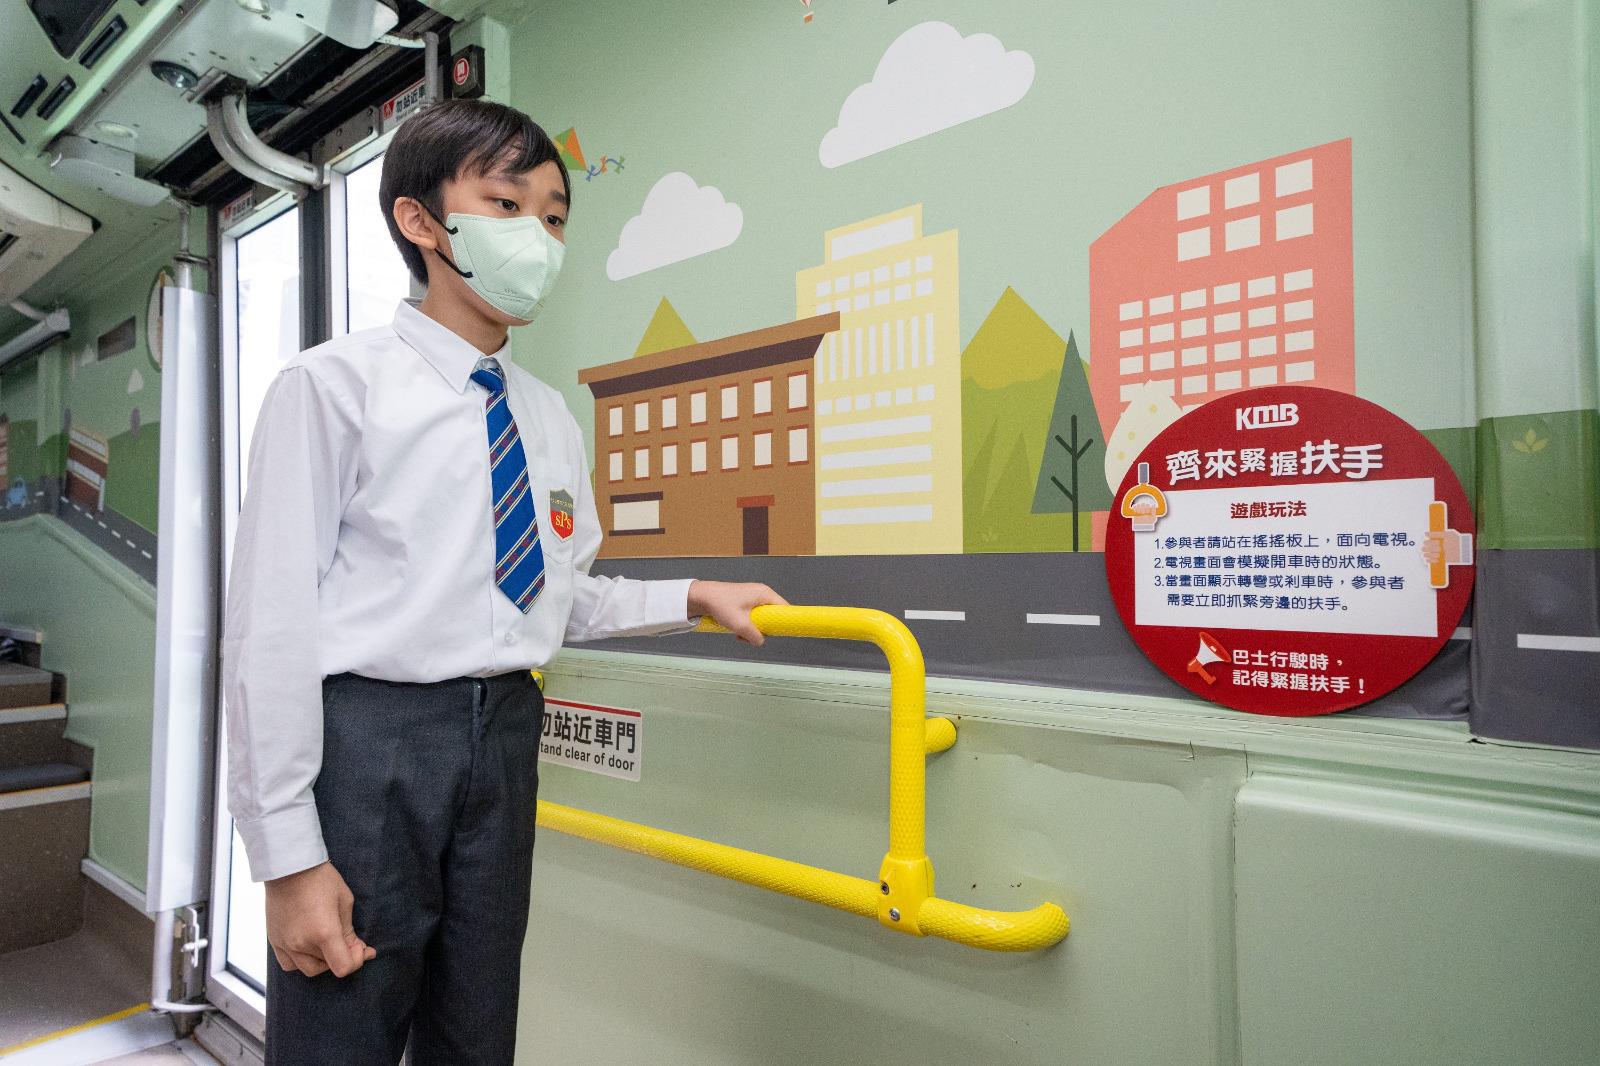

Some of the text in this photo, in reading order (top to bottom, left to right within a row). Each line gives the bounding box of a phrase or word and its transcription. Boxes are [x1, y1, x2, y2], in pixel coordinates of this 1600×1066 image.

[1235, 403, 1299, 431] KMB
[1165, 438, 1383, 486] 齊來緊握扶手
[1230, 500, 1307, 519] 遊戲玩法
[1167, 593, 1348, 611] 需要立即抓緊旁邊的扶手。
[1233, 650, 1343, 671] 巴士行駛時，
[1233, 669, 1365, 694] 記得緊握扶手！
[540, 741, 635, 772] tand clear of door
